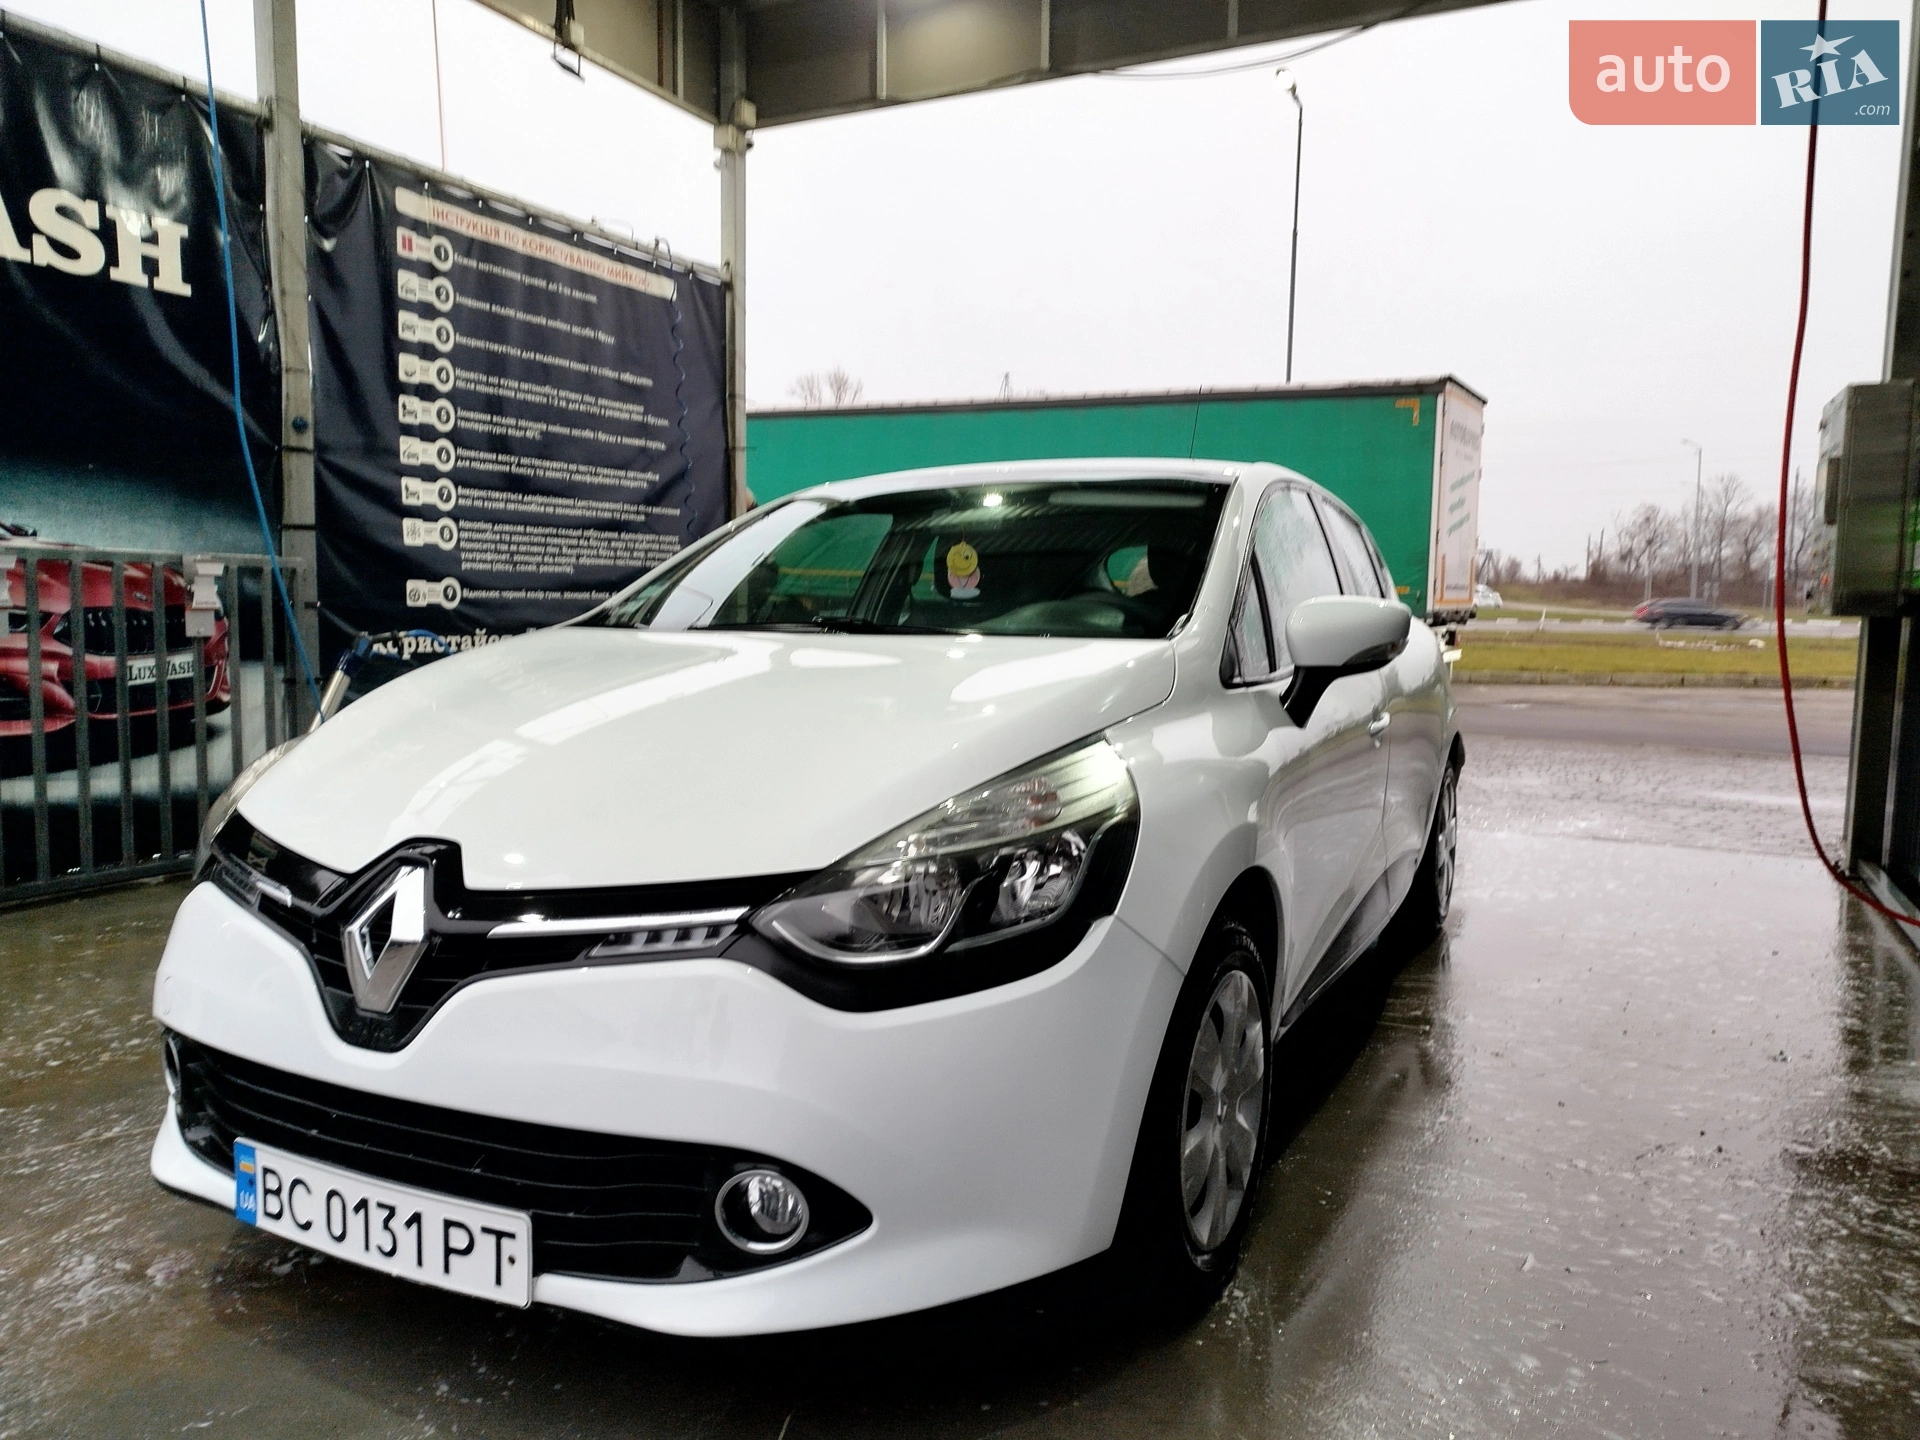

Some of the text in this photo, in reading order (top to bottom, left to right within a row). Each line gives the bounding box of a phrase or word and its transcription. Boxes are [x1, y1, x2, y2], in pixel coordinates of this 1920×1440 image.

[128, 664, 155, 682] LUX
[262, 1165, 516, 1287] BC 0131 PT
